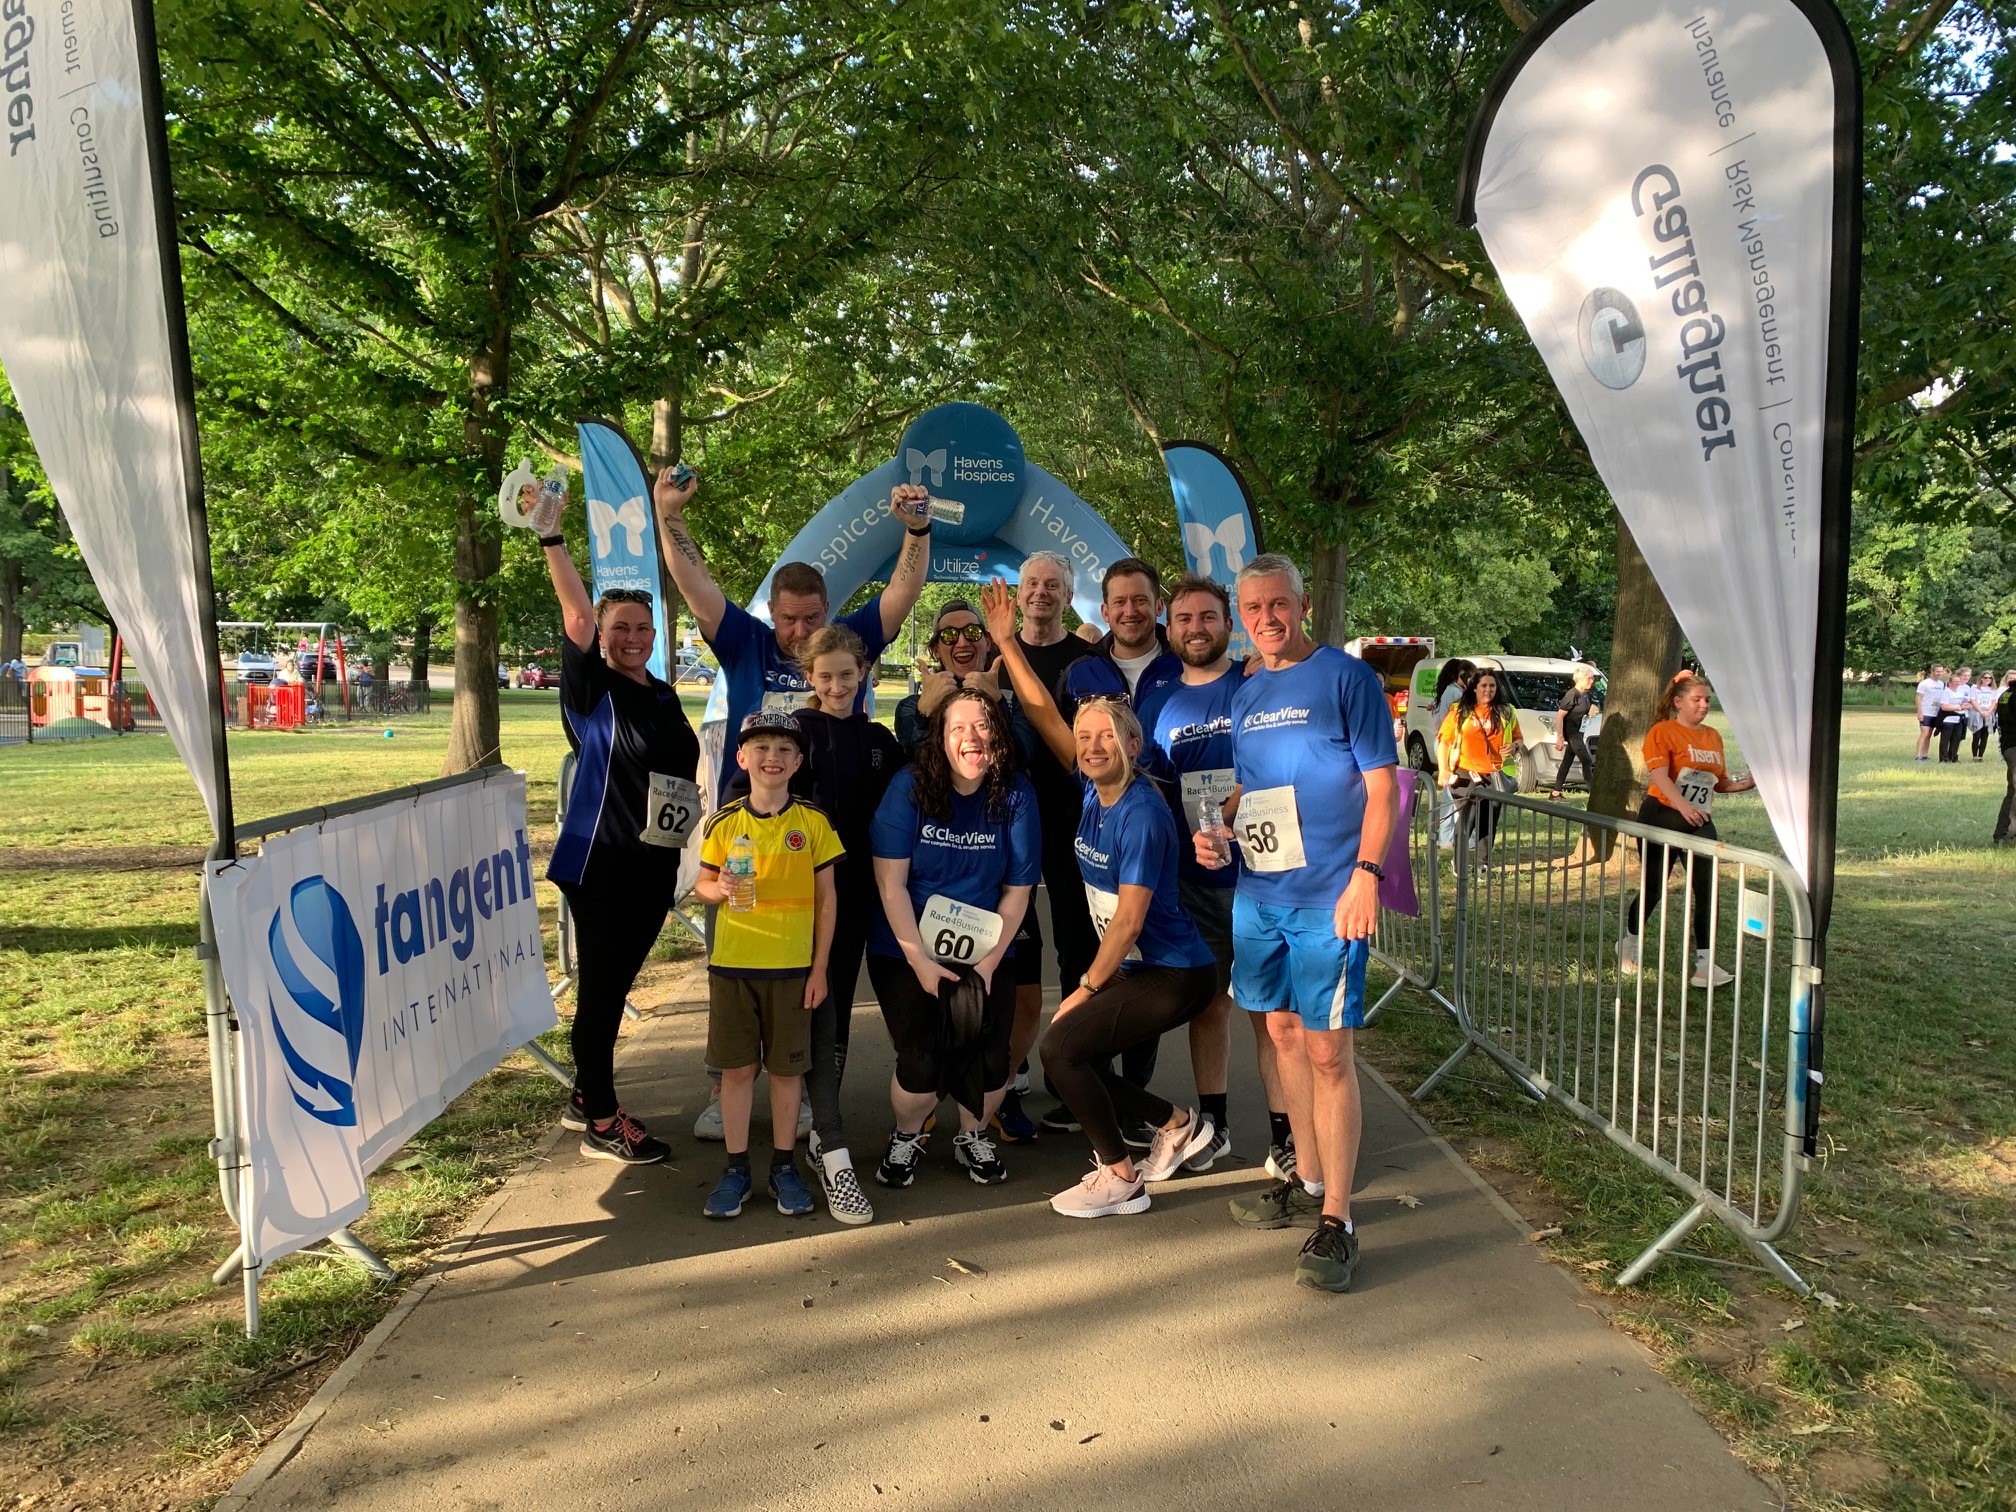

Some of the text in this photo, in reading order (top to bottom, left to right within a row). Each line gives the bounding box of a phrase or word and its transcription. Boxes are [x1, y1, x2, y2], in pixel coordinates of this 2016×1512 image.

[953, 456, 1003, 470] Havens
[953, 469, 1015, 484] Hospices
[811, 498, 892, 577] ospices
[1029, 496, 1108, 583] Havens
[596, 565, 639, 577] Havens
[933, 557, 980, 574] Utilize
[597, 577, 652, 590] Hospices
[777, 673, 807, 689] Clear
[1253, 706, 1310, 725] ClearView
[1182, 716, 1232, 737] ClearVie
[1680, 783, 1709, 805] 173
[657, 802, 690, 834] 62
[936, 828, 996, 845] ClearView
[1245, 820, 1279, 854] 58
[375, 829, 531, 976] tangent
[929, 909, 994, 938] Race4Business
[934, 928, 975, 961] 60
[383, 934, 535, 1051] INTENATINAL
